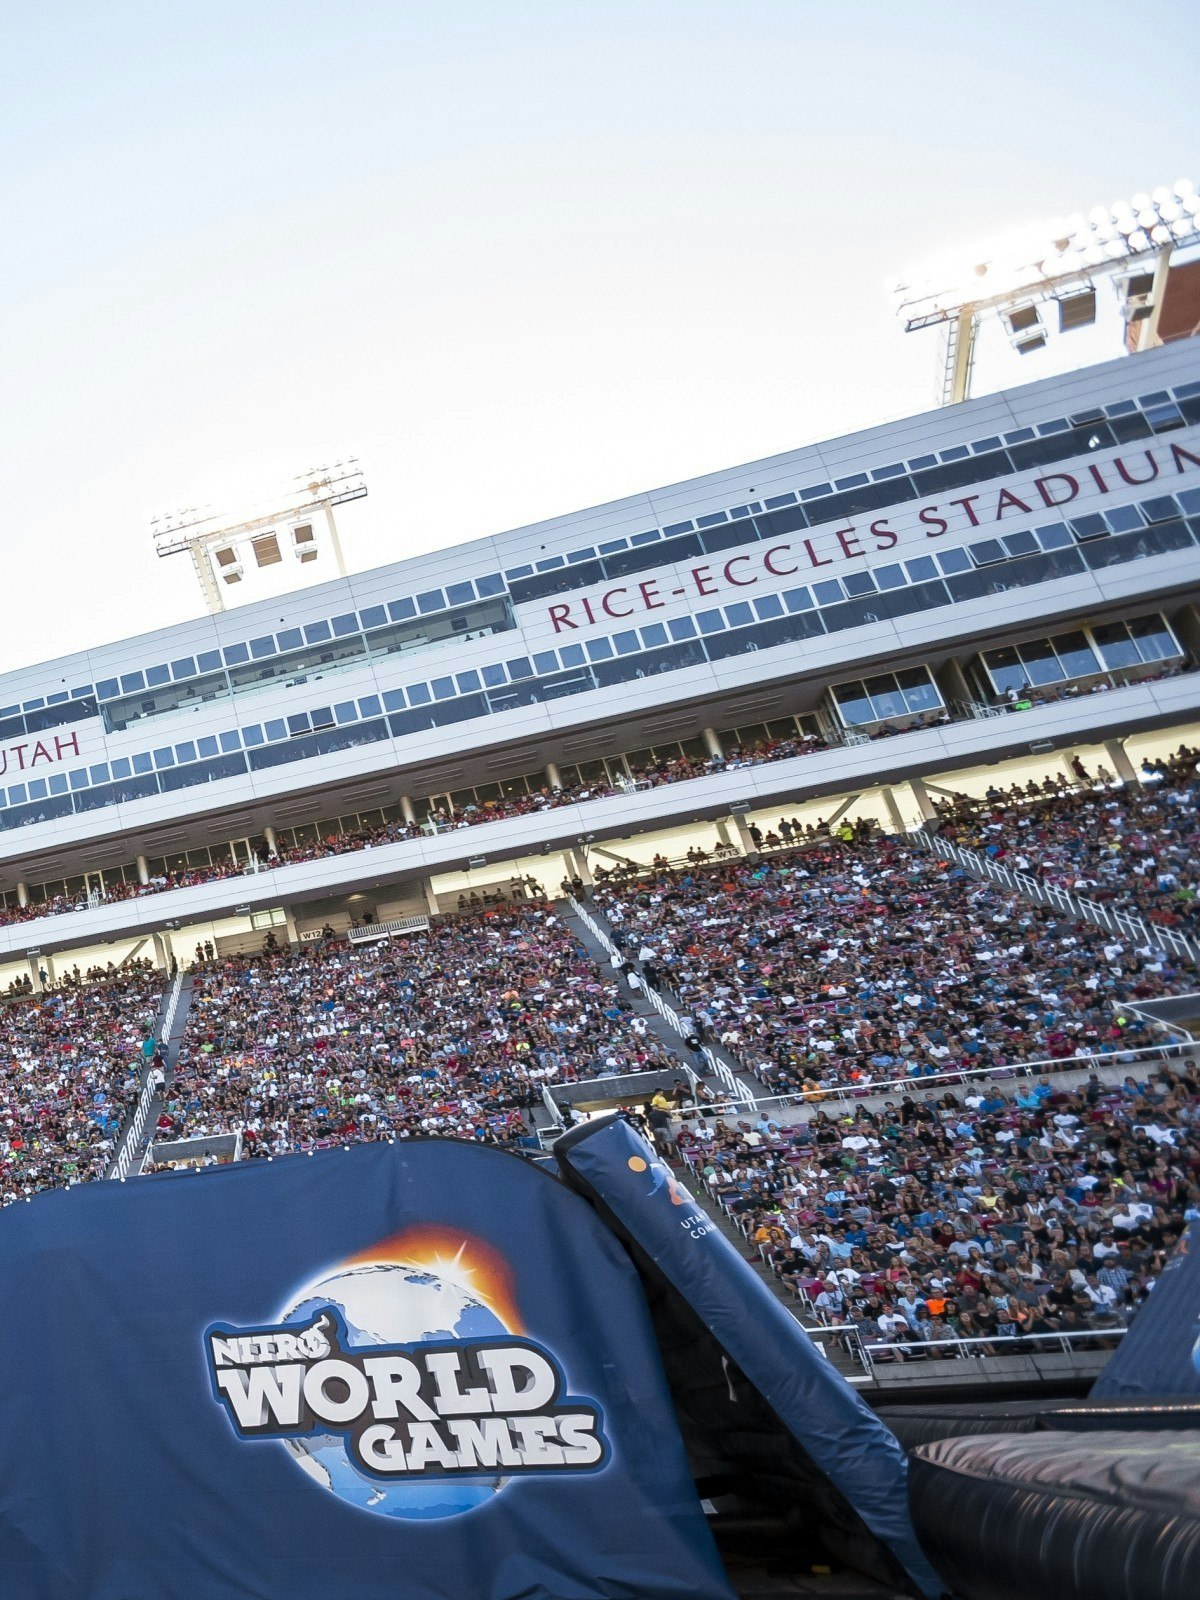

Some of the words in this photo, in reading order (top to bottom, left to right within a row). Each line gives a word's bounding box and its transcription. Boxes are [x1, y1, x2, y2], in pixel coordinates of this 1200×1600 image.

[548, 518, 899, 634] RICE-ECCLES
[716, 848, 740, 859] W13
[302, 930, 322, 940] W12
[210, 1314, 332, 1366] NITRO
[216, 1347, 556, 1429] WORLD
[357, 1413, 602, 1473] GAMES
